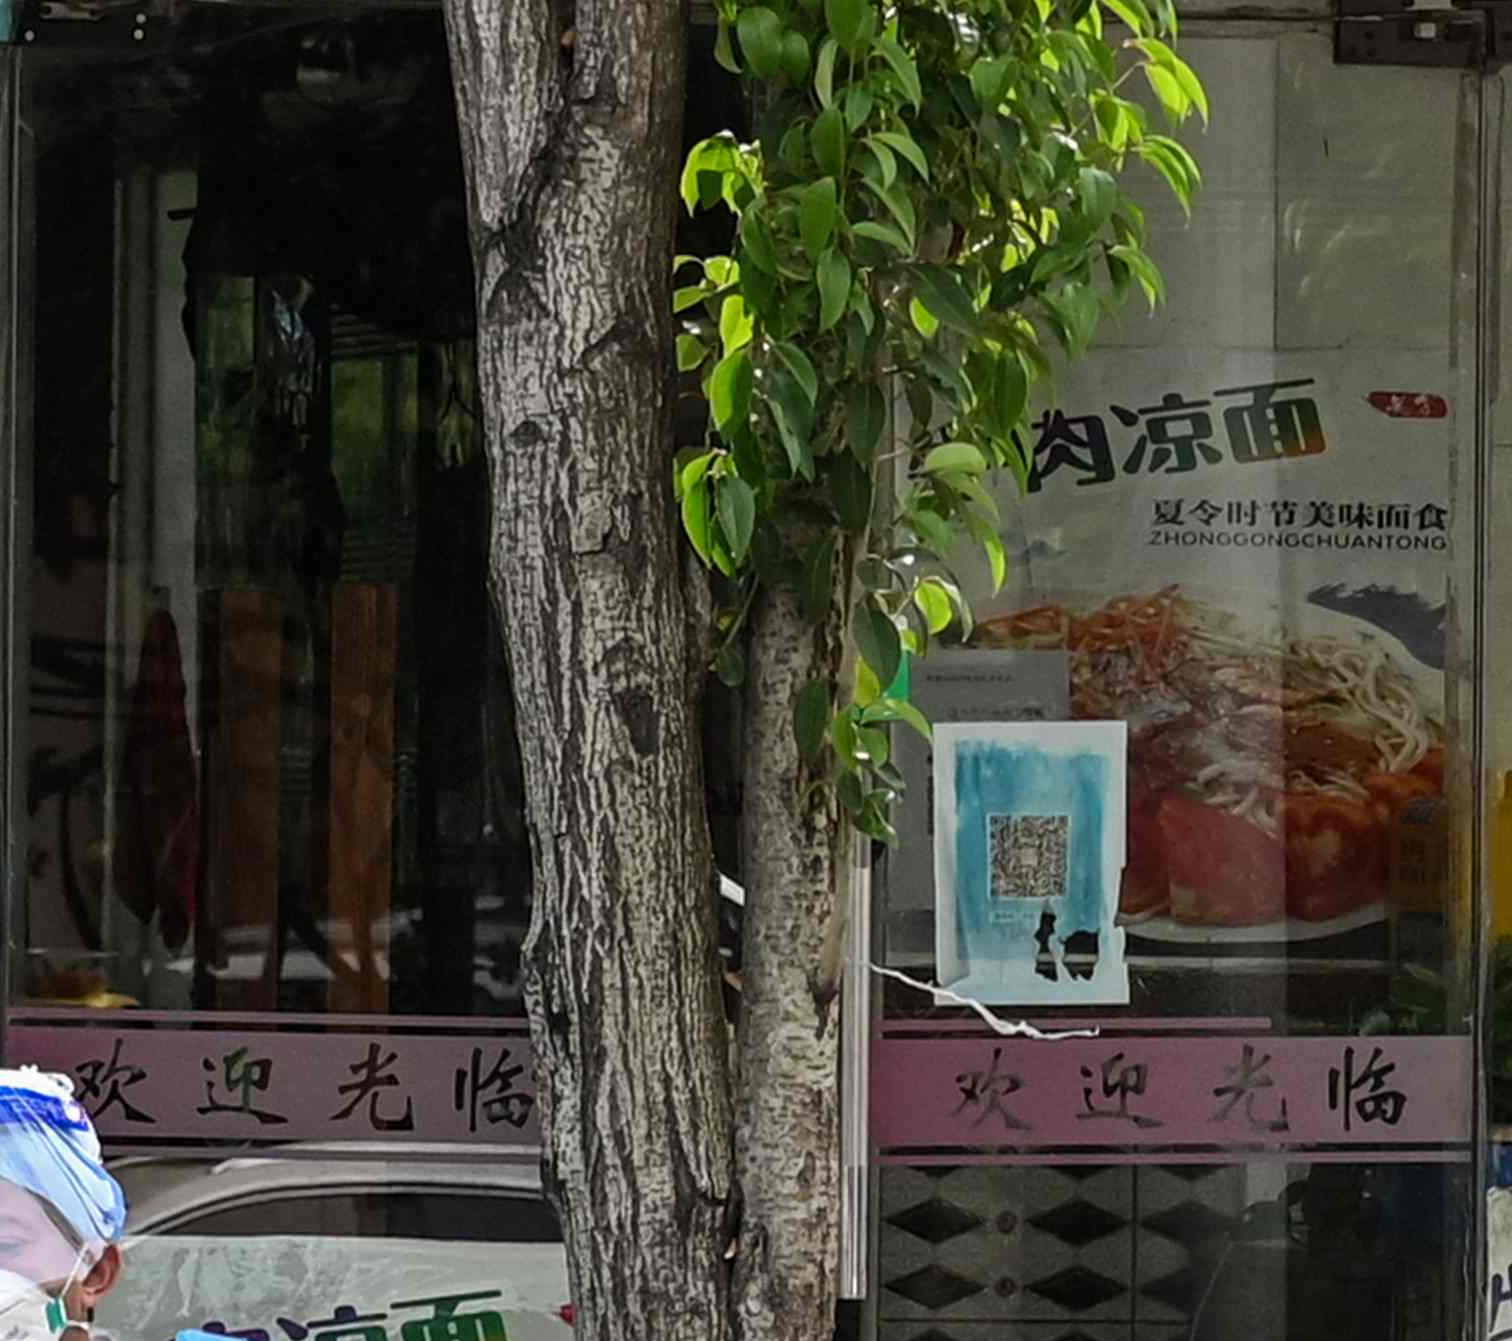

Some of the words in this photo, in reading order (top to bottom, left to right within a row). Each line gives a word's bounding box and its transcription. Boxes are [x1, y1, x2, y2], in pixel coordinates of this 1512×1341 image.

[1153, 501, 1449, 531] 夏令时节美味面食
[72, 1036, 536, 1133] 欢迎光临
[954, 1045, 1409, 1133] 欢迎光临
